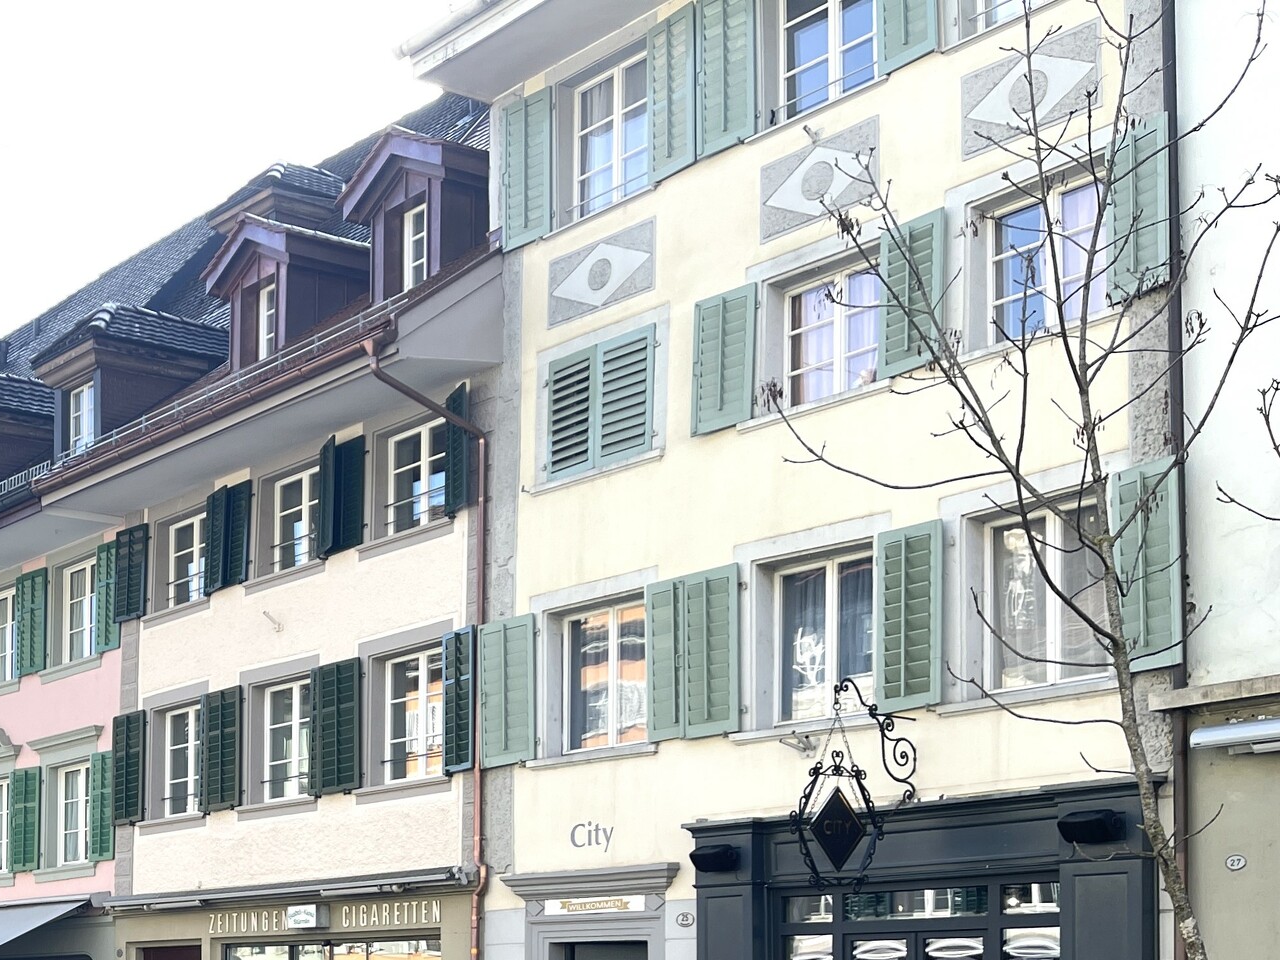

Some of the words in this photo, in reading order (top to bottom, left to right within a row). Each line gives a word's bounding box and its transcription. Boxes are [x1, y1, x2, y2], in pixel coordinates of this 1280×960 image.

[823, 820, 852, 835] CITY
[570, 821, 614, 853] City
[1230, 858, 1241, 867] 27
[568, 899, 622, 911] WILLKOMMEN
[341, 899, 442, 928] CIGARETTEN
